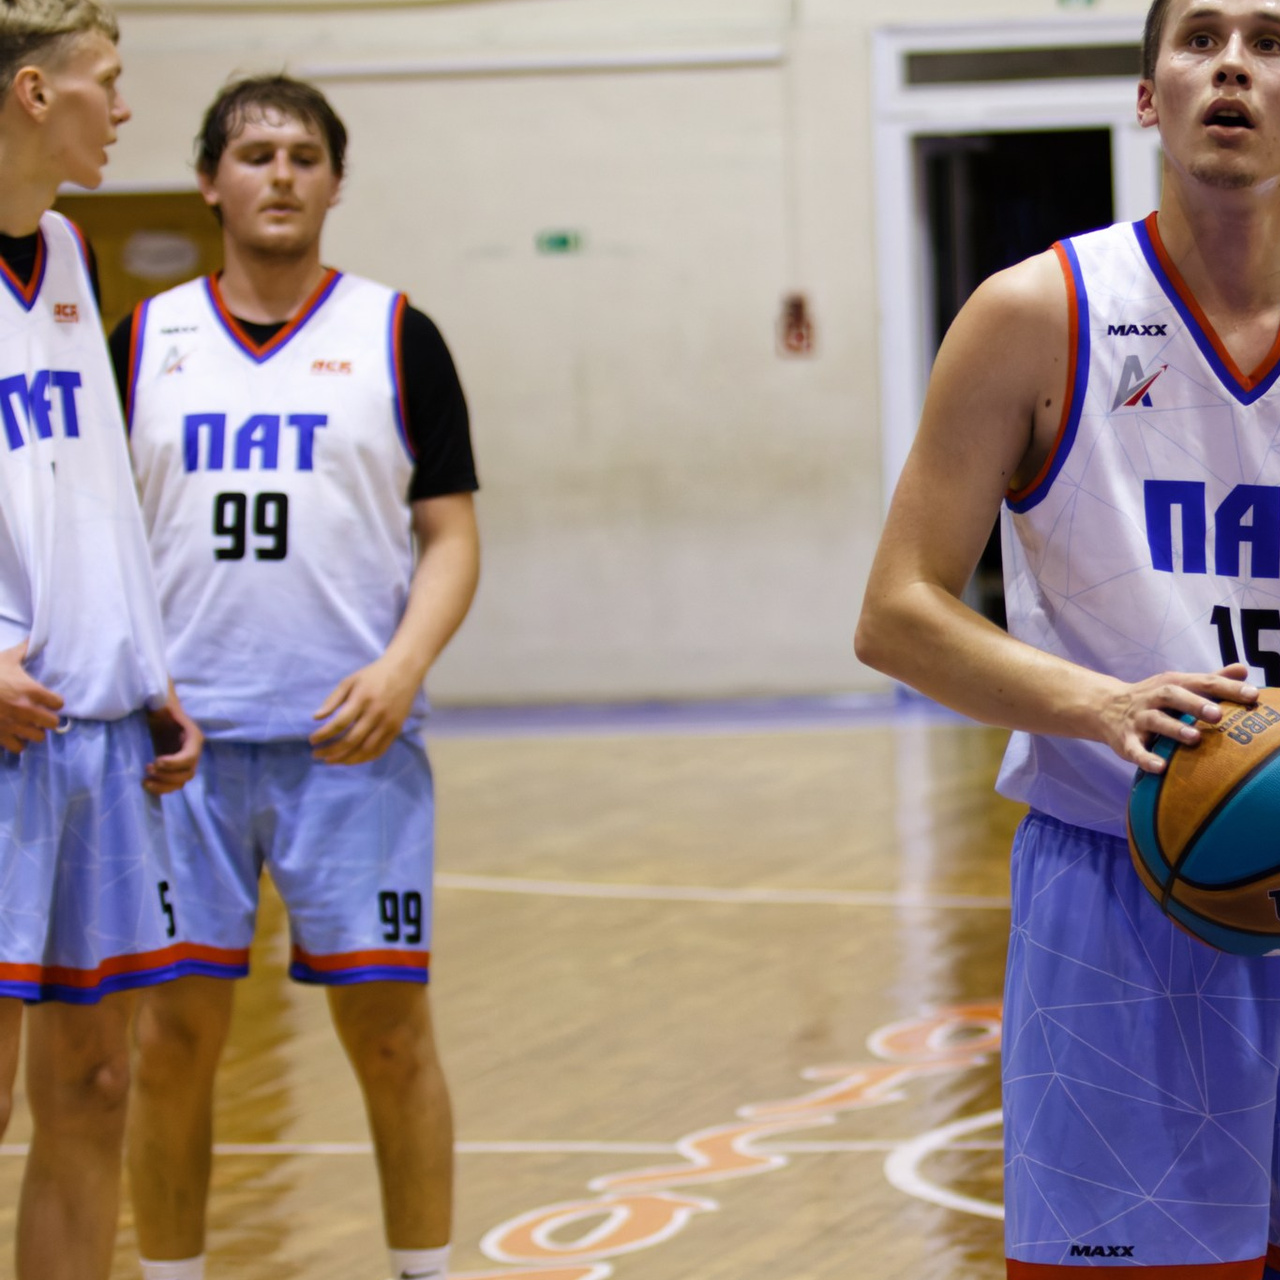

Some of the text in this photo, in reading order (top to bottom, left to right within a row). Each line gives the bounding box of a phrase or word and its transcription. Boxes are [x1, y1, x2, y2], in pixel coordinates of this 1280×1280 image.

[1107, 324, 1168, 336] MAXX
[184, 413, 328, 473] ПАТ
[214, 492, 289, 562] 99
[378, 891, 422, 943] 99
[1070, 1245, 1135, 1257] MAXX
